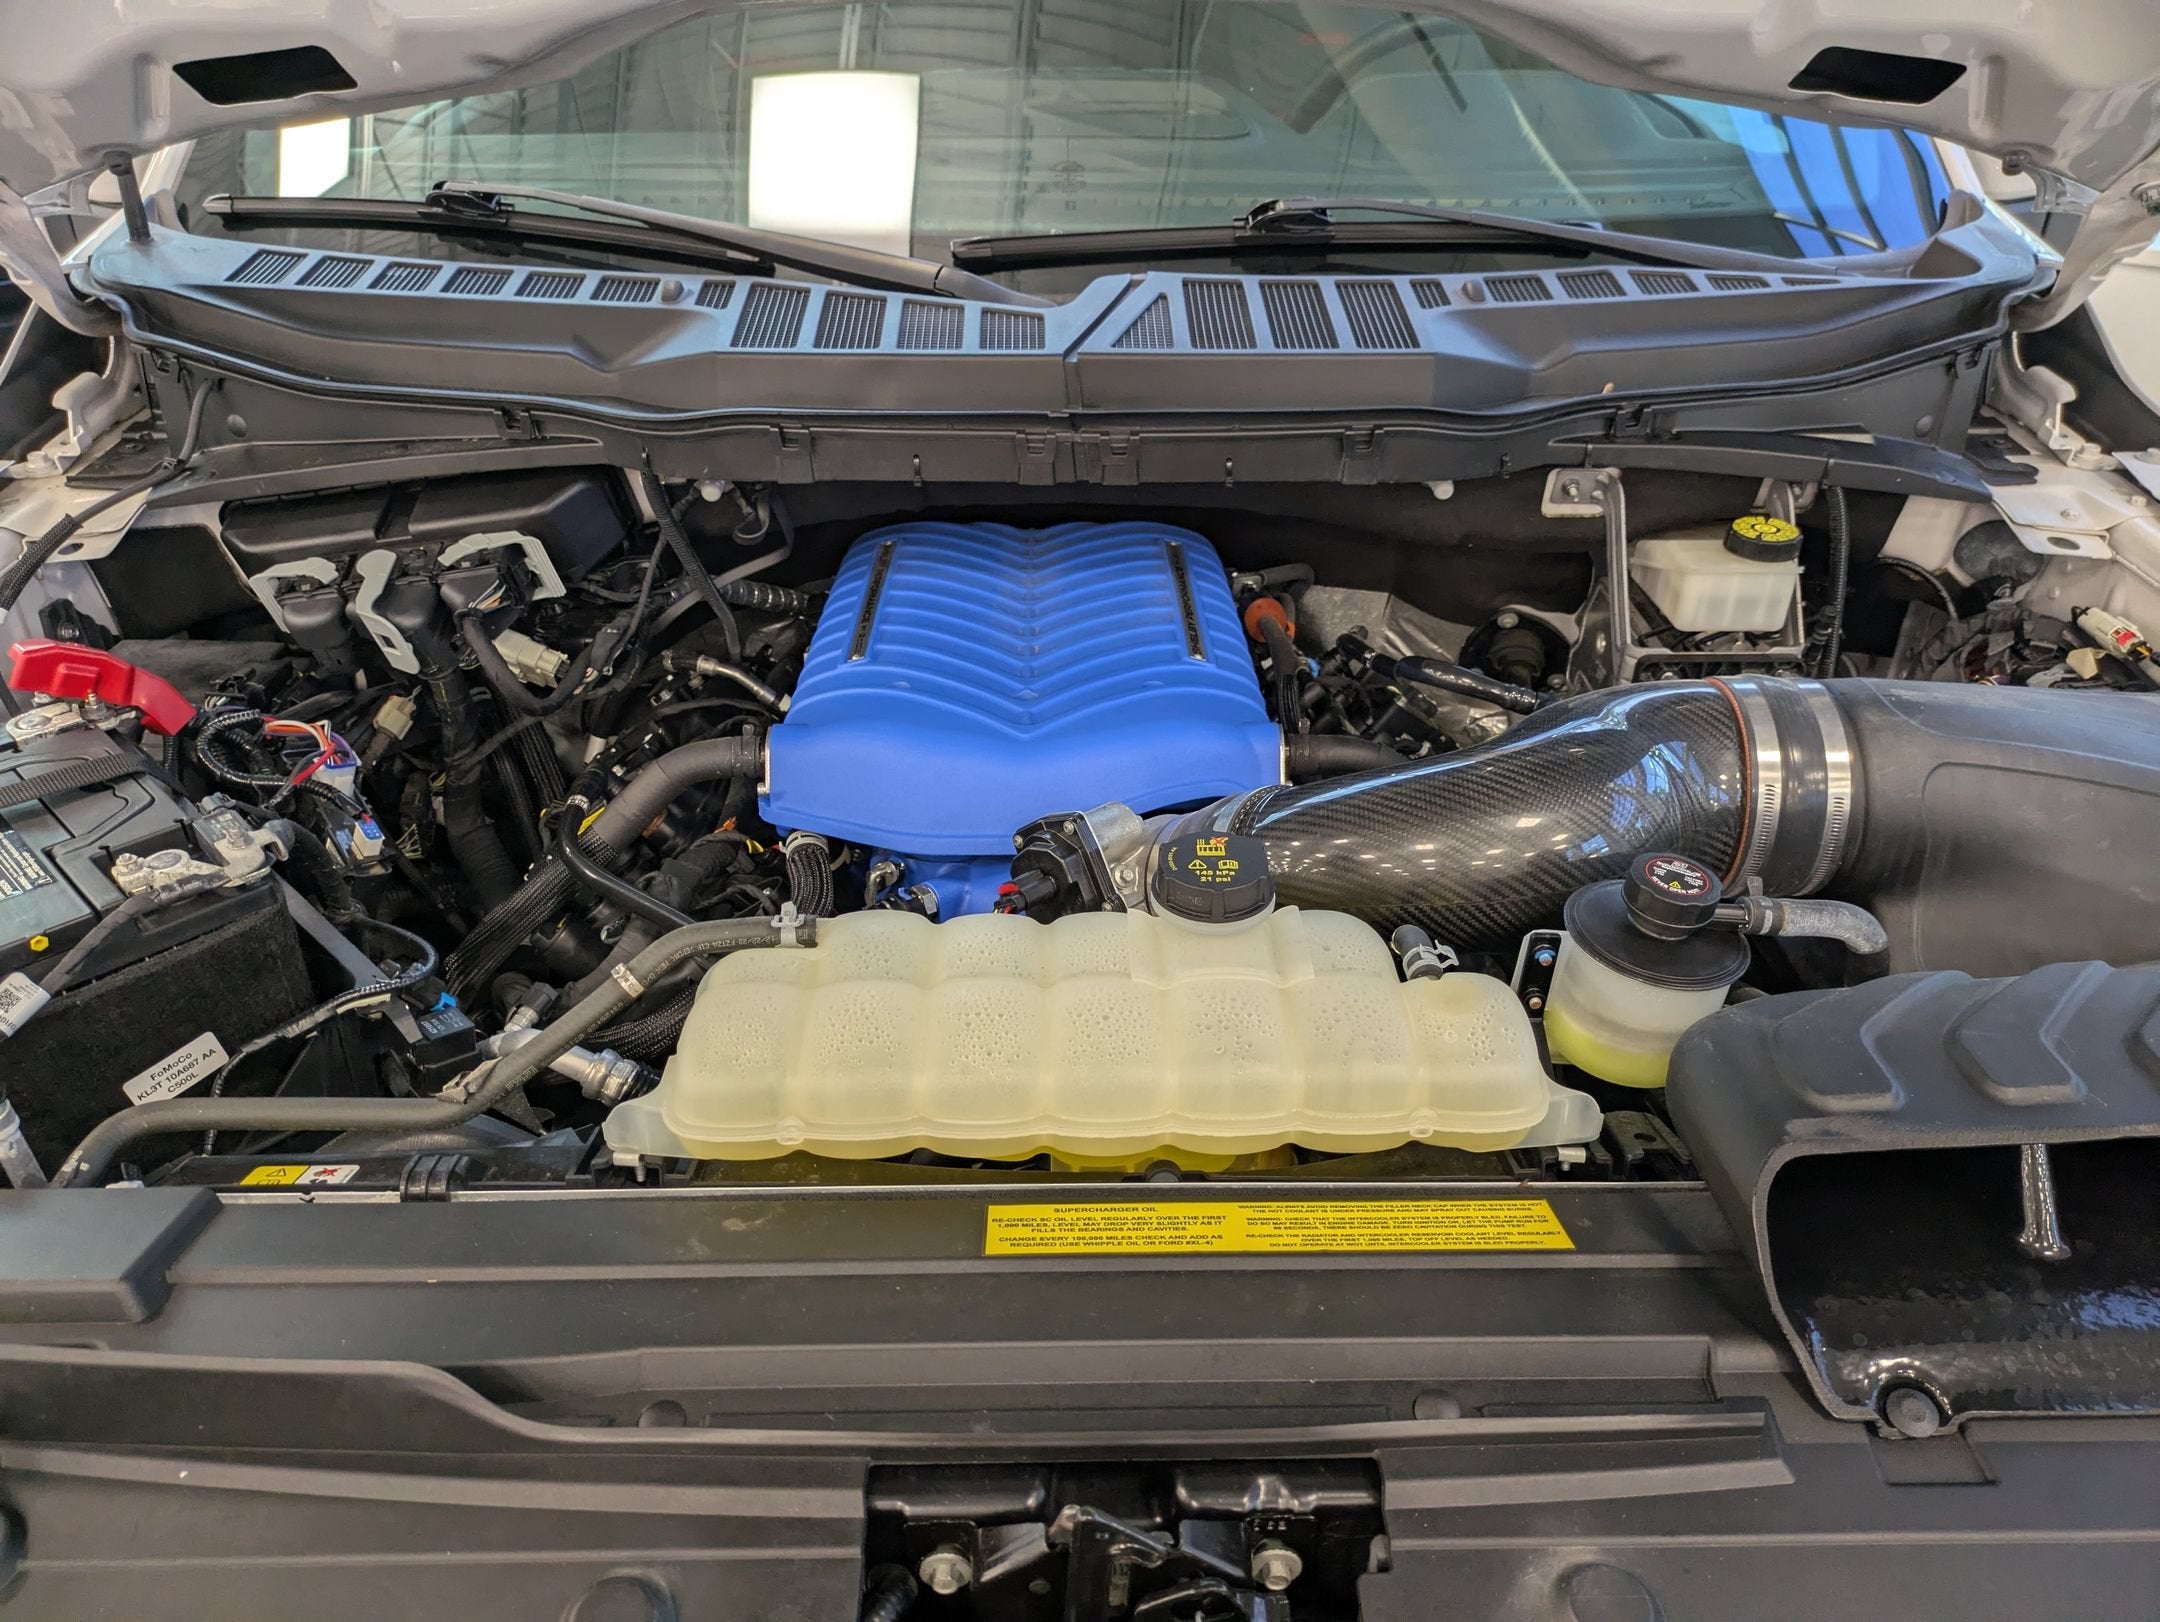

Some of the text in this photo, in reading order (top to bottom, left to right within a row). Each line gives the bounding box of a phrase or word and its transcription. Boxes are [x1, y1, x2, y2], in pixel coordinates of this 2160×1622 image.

[137, 1049, 217, 1101] KL3T 10A687 AA
[150, 1052, 192, 1080] FoMoCo
[167, 1073, 199, 1093] C500L
